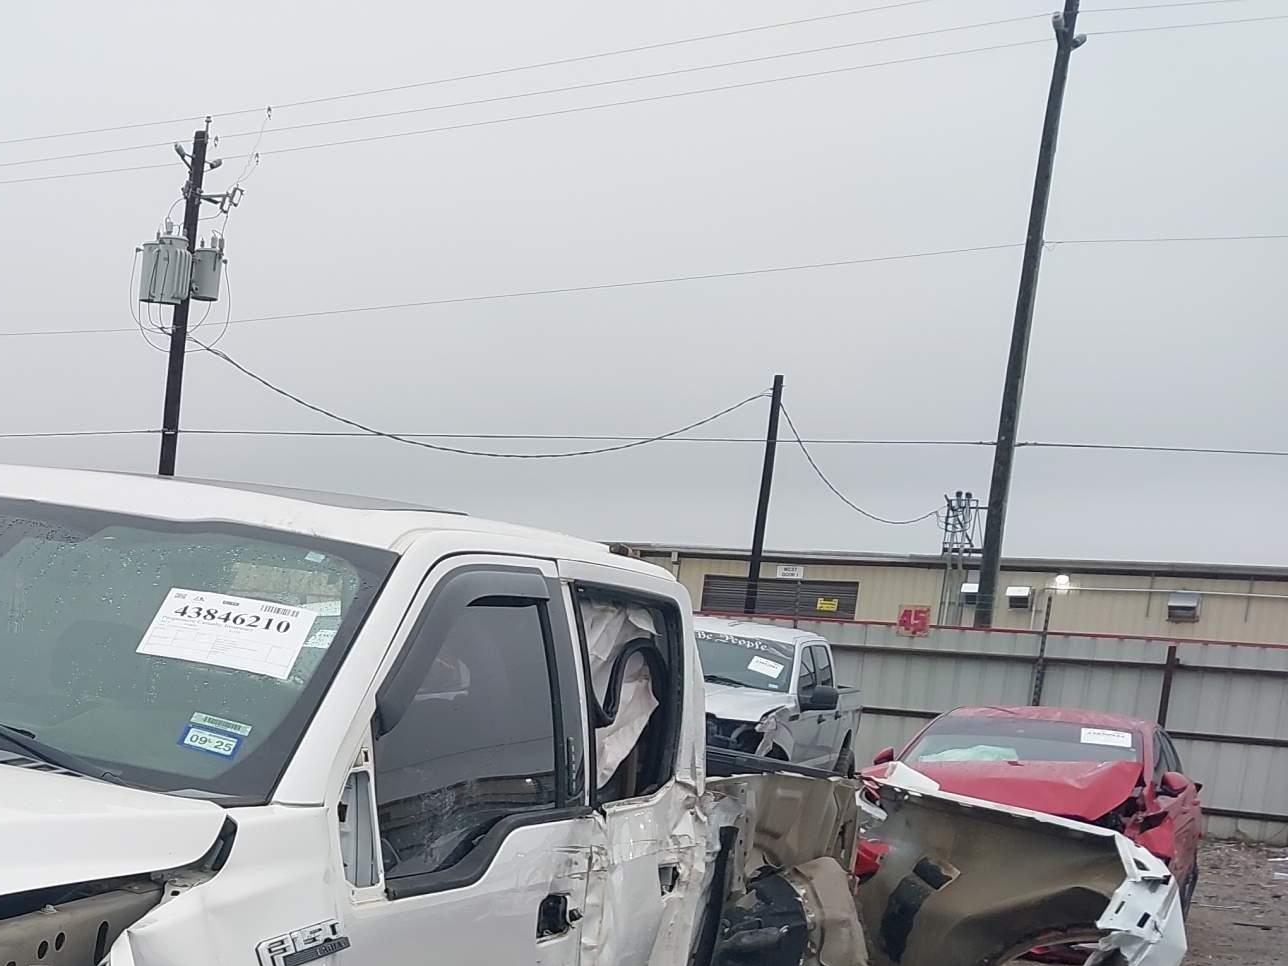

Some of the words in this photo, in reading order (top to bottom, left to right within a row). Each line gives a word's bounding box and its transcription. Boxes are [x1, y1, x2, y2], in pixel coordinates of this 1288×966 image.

[174, 604, 291, 634] 43846210
[190, 734, 208, 745] 09
[214, 740, 233, 752] 25
